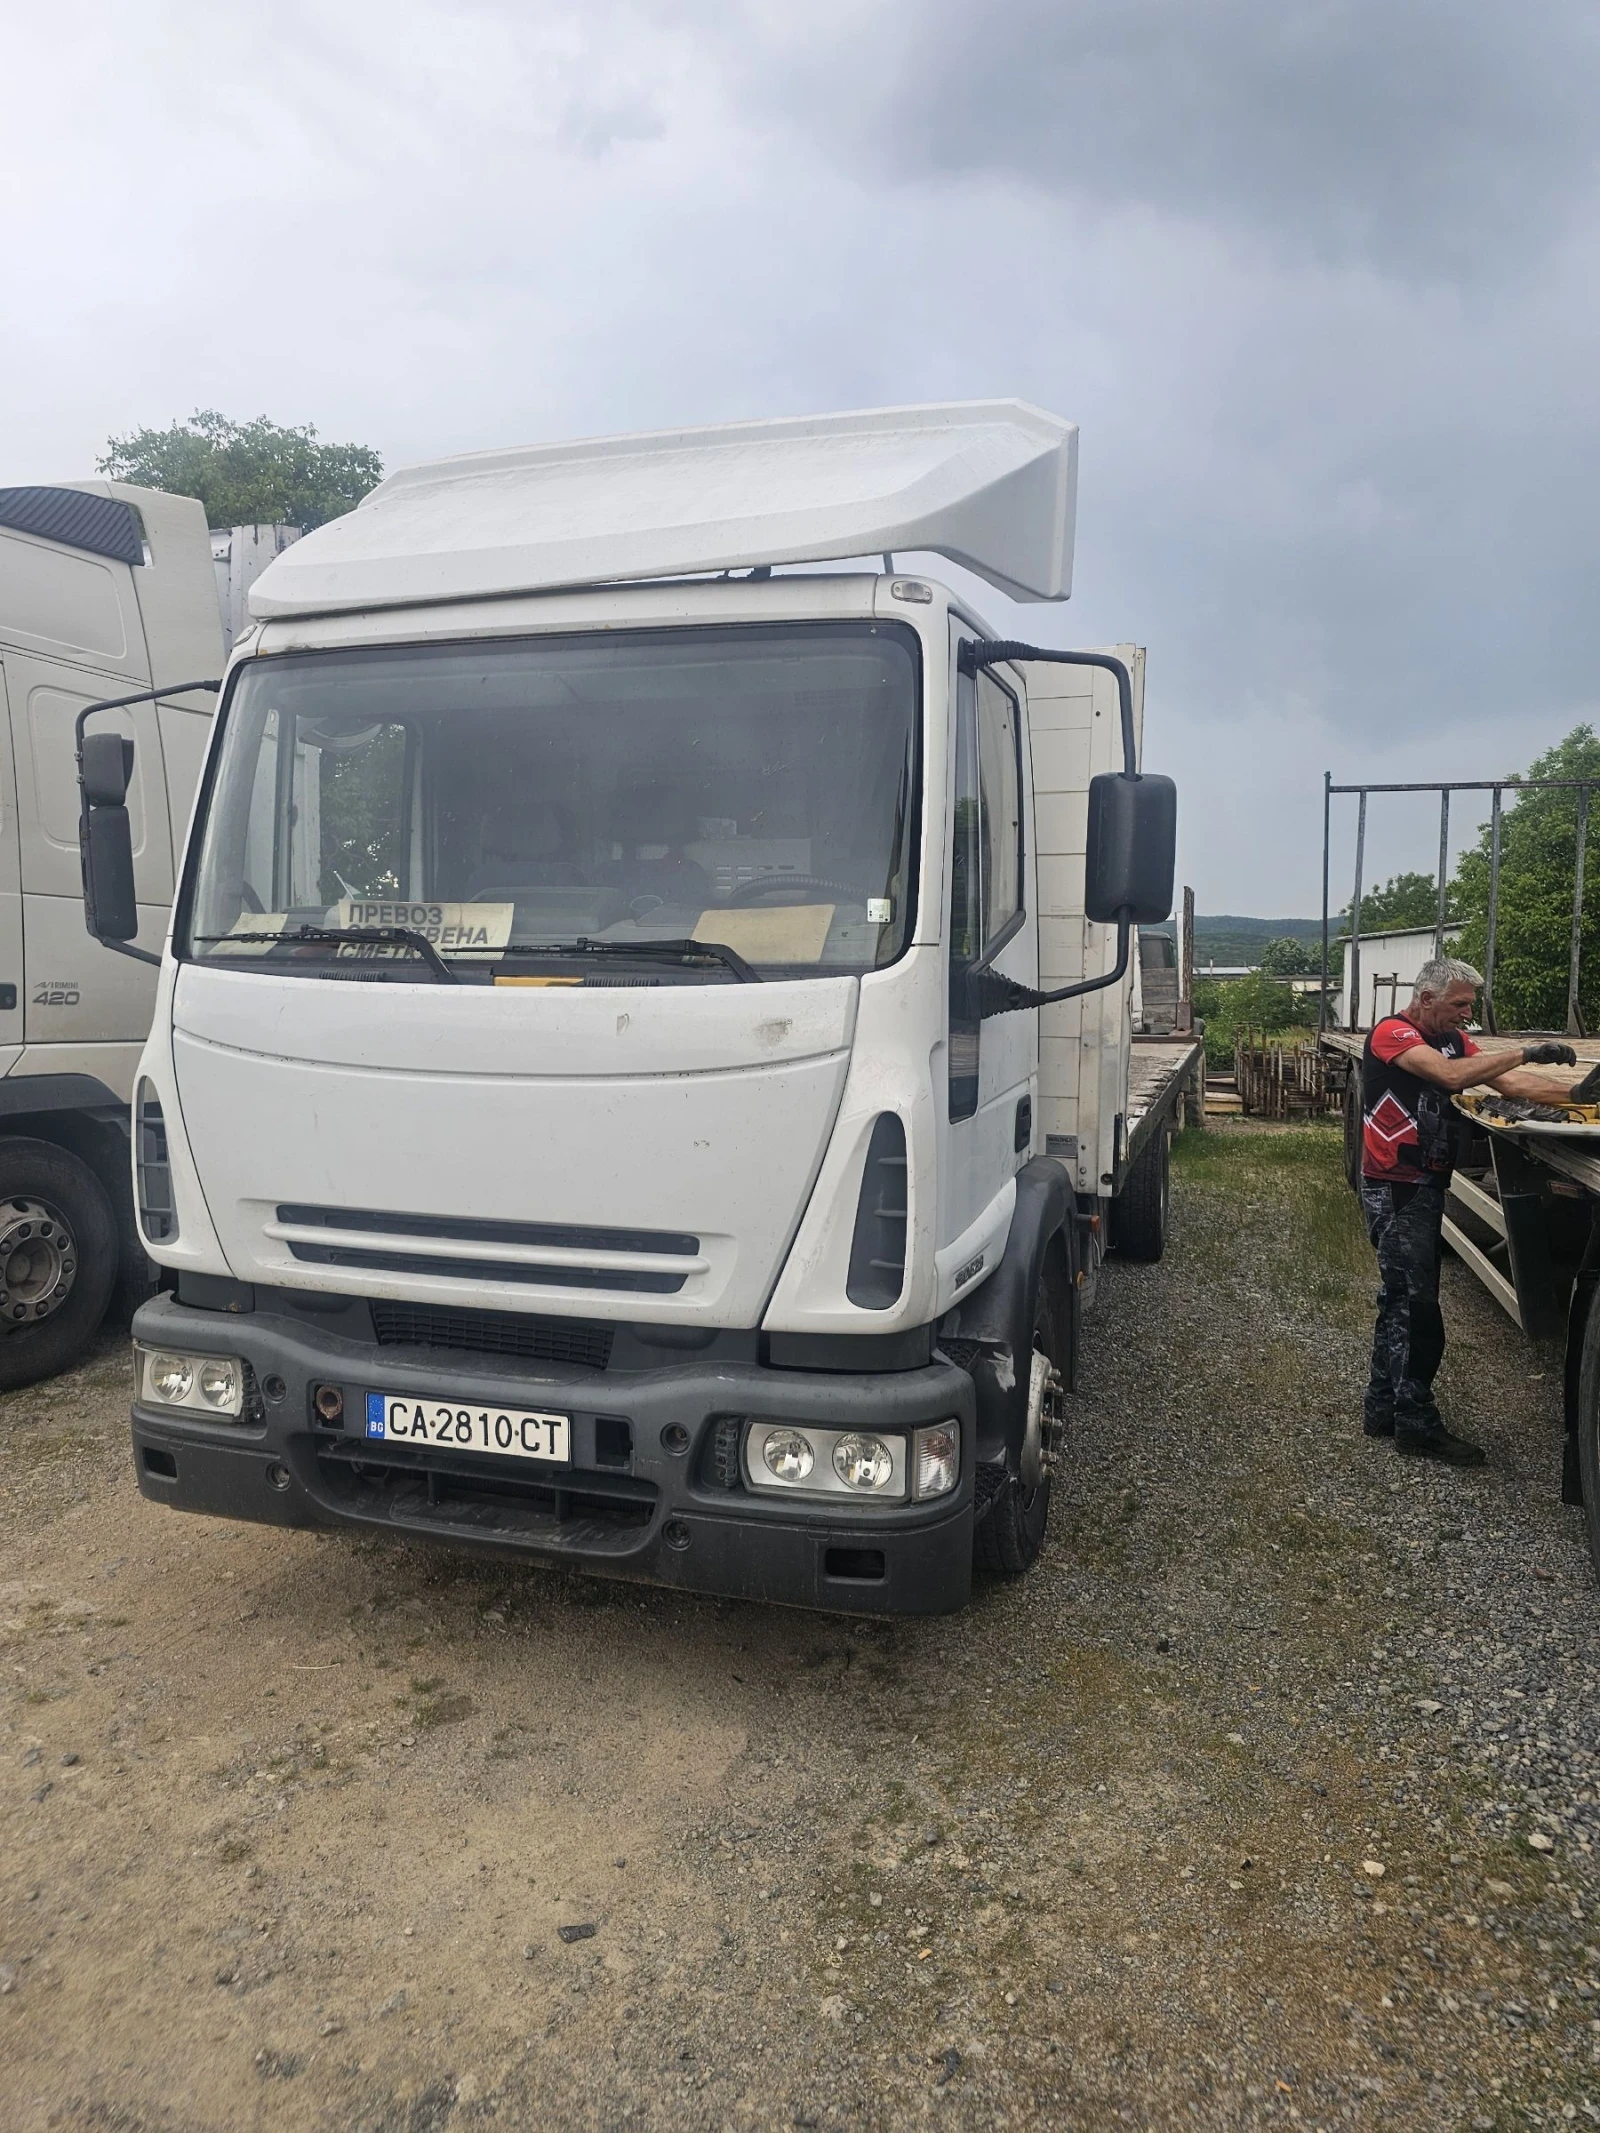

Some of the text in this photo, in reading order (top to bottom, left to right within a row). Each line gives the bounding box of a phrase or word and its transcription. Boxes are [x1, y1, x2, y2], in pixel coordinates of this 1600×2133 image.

[349, 904, 443, 925] ПРЕВОЗ
[32, 991, 80, 1006] 420
[370, 1421, 384, 1433] BG
